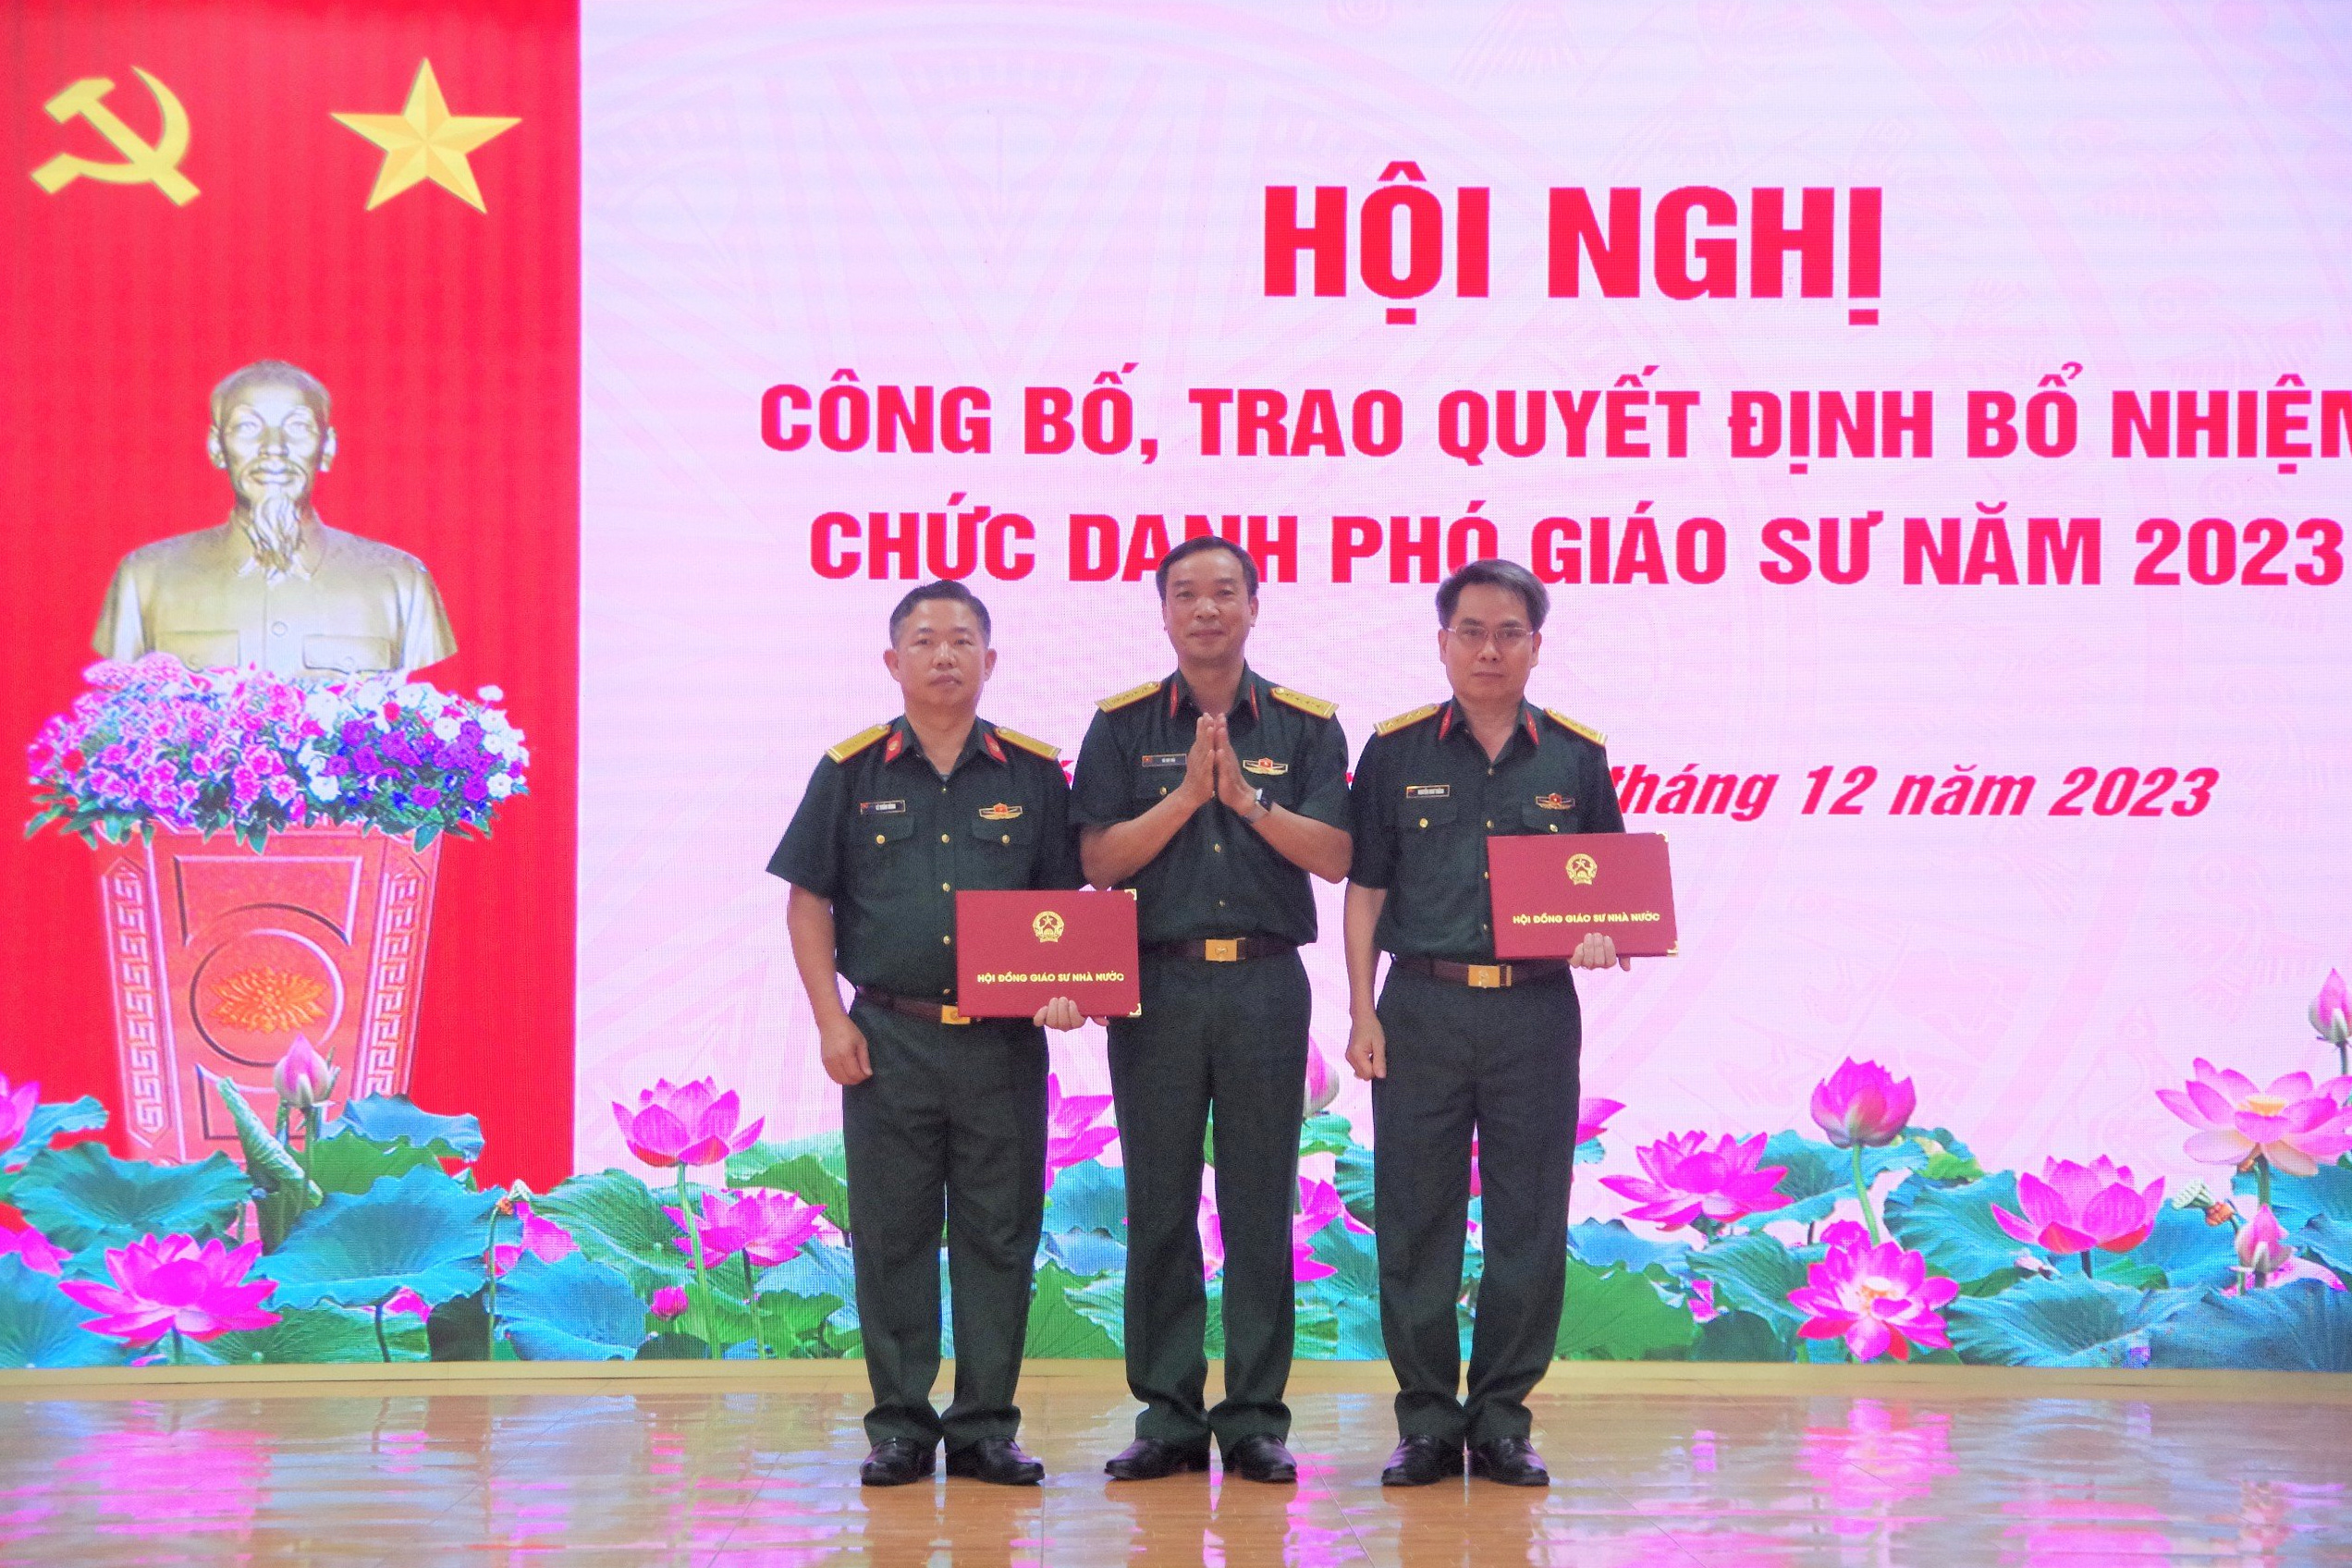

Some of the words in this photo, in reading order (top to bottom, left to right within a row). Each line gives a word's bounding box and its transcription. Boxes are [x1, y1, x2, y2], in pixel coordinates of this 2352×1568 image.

[1264, 161, 1490, 325] HỘI
[1548, 186, 1882, 325] NGHỊ
[761, 369, 992, 453] CÔNG
[1023, 362, 1158, 464] BỐ,
[1188, 388, 1403, 457] TRAO
[1439, 365, 1700, 466] QUYẾT
[1728, 390, 1933, 474] ĐỊNH
[1967, 361, 2082, 458] BỔ
[810, 492, 1035, 581] CHỨC
[1331, 500, 1499, 584] PHÓ
[1531, 501, 1727, 584] GIÁO
[1759, 510, 1884, 584] SƯ
[1903, 501, 2101, 585] NĂM
[2134, 518, 2345, 585] 2023
[1801, 766, 1878, 815] 12
[1888, 765, 2037, 815] năm
[2048, 766, 2220, 816] 2023
[1513, 913, 1531, 925] HỘI
[1533, 913, 1563, 924] ĐỒNG
[1565, 913, 1591, 924] GIÁO
[1593, 913, 1606, 923] SƯ
[1608, 912, 1629, 922] NHÀ
[1631, 911, 1660, 922] NƯỚC
[976, 972, 996, 984] HỘI
[998, 971, 1028, 983] ĐỒNG
[1030, 972, 1056, 983] GIÁO
[1058, 973, 1072, 983] SƯ
[1072, 971, 1094, 982] NHÀ
[1096, 970, 1124, 982] NƯỚC
